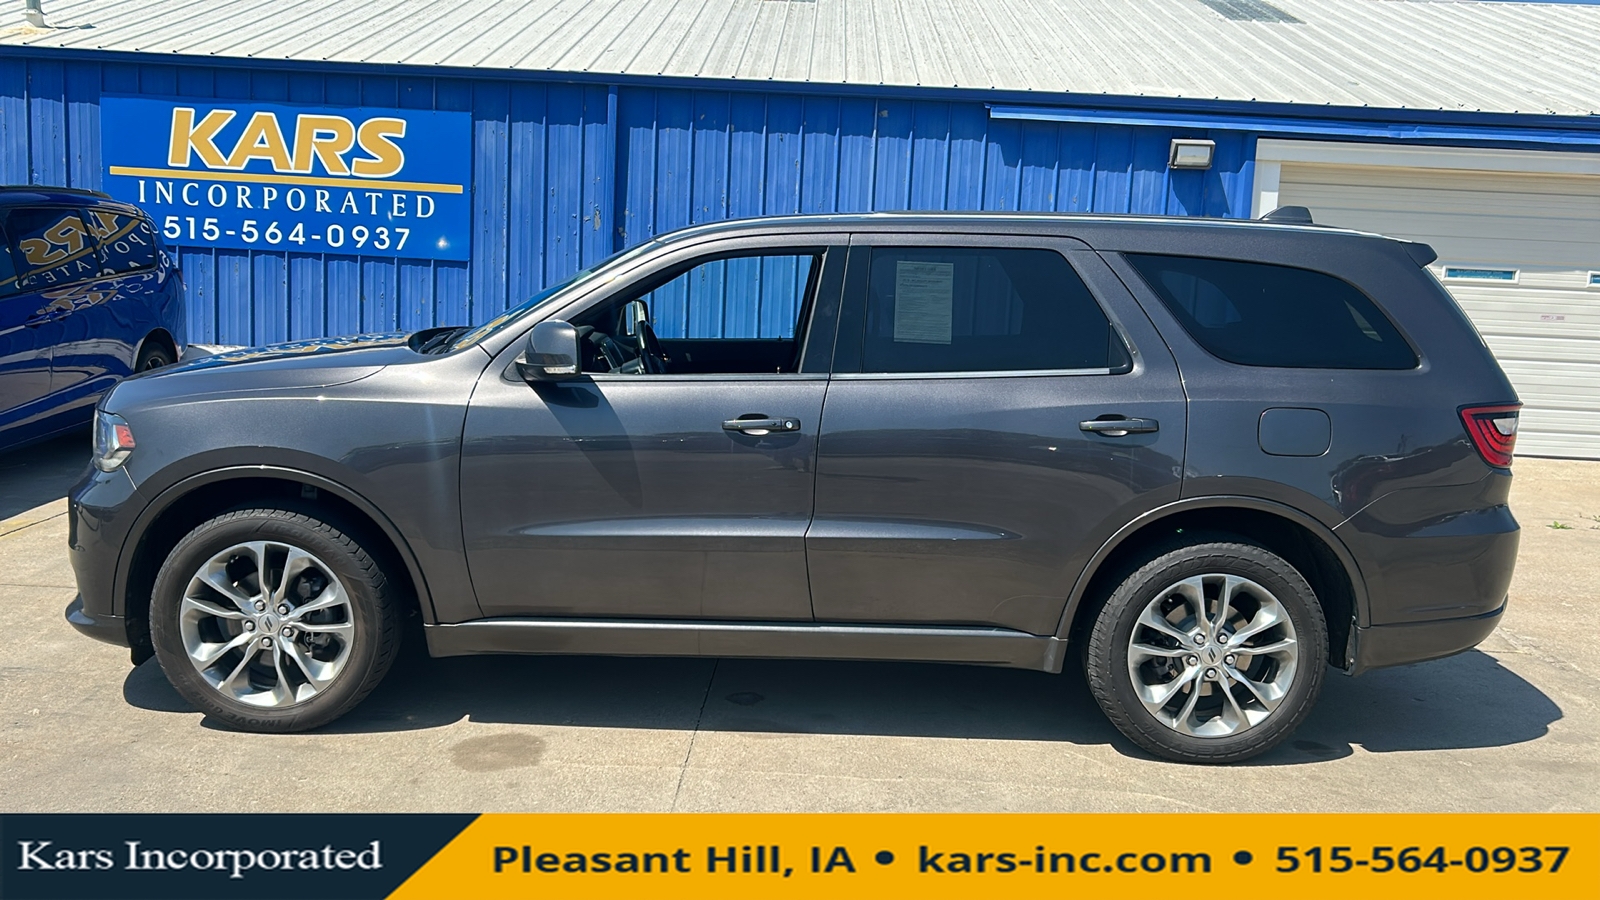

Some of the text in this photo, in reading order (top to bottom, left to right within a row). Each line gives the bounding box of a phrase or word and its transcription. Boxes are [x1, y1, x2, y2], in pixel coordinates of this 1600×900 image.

[168, 107, 407, 178] KARS
[138, 179, 436, 219] INCORPORATED
[163, 215, 411, 251] 515-564-0937
